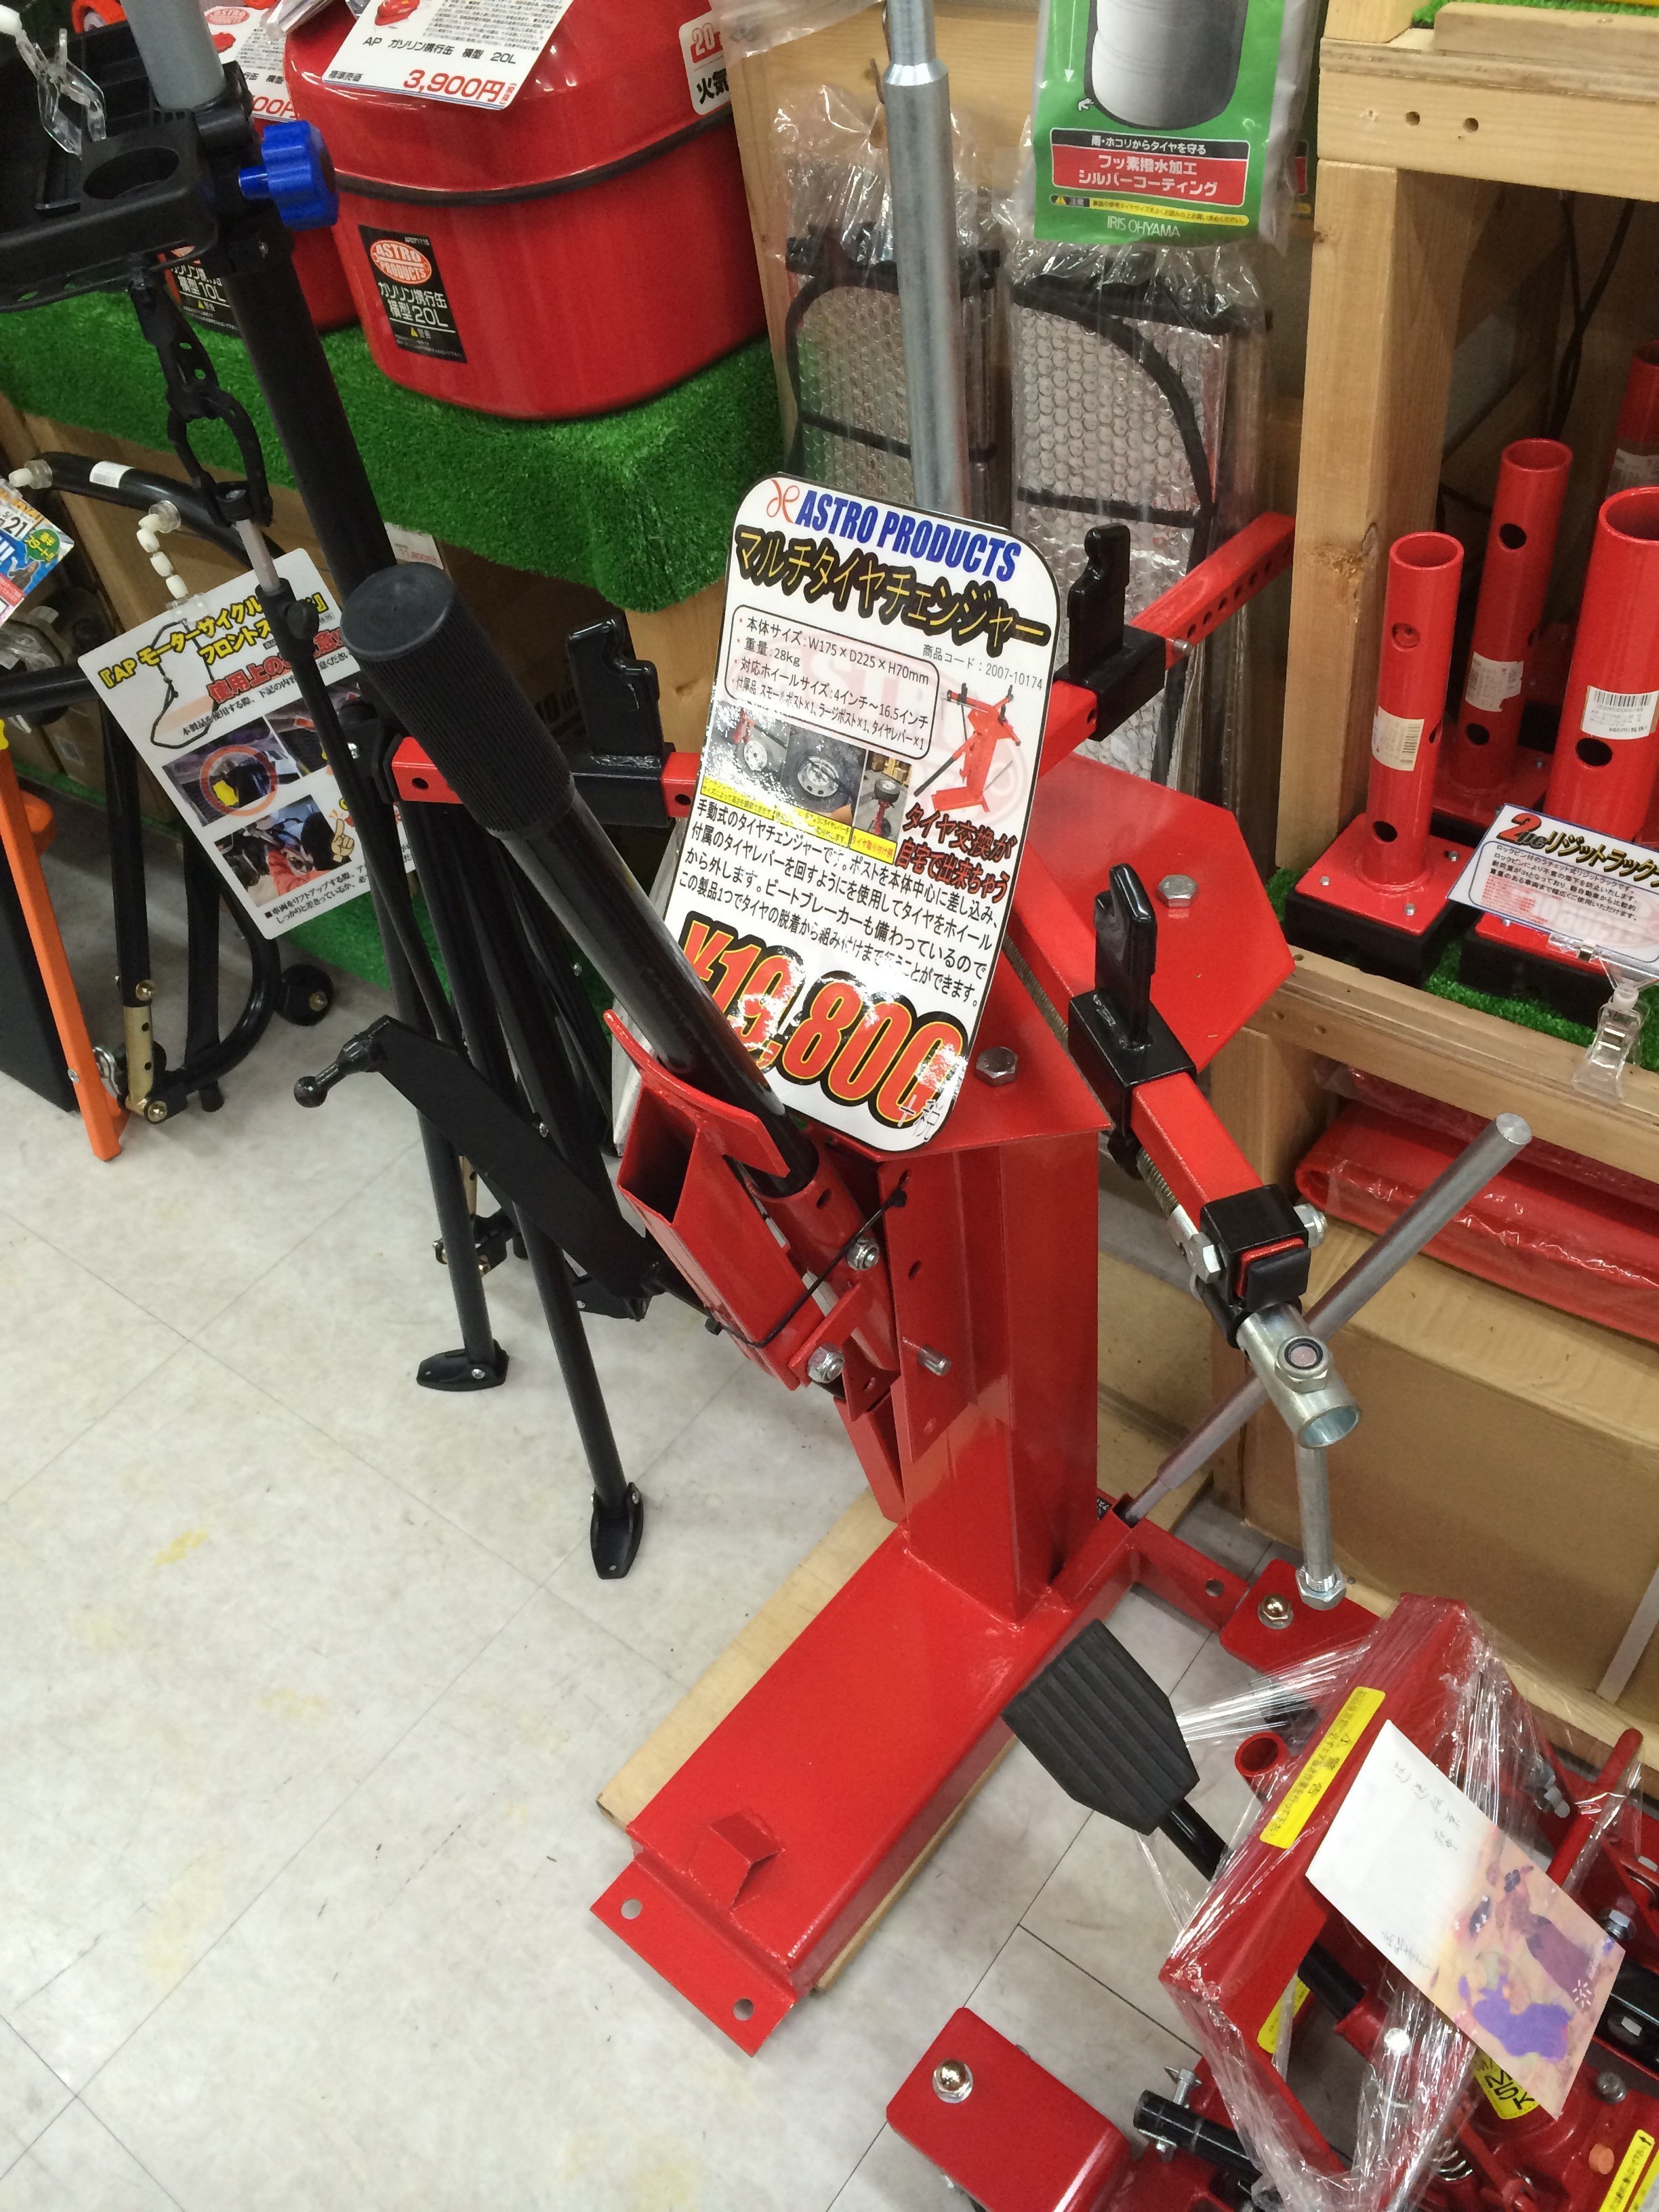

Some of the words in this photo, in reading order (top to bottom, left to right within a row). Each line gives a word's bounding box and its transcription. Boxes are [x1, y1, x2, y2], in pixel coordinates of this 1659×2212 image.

[363, 37, 382, 46] AP
[388, 39, 455, 56] ガソリン携行缶
[490, 52, 516, 64] 20L
[403, 69, 506, 102] 3,900円
[1091, 135, 1206, 155] 雨・ホコリからタイヤを守る
[1098, 155, 1197, 176] フッ素撥水加工
[1078, 169, 1218, 197] シルバーコーティング
[1107, 216, 1126, 231] IRIS
[1128, 220, 1181, 237] OHYAMA
[375, 243, 422, 262] ASTRO
[380, 261, 426, 281] PRODUCTS
[378, 281, 447, 309] ガソリン携行缶
[795, 490, 878, 544] ASTRO
[877, 510, 1021, 581] PRODUCTS
[736, 527, 1050, 655] マルチタイヤチェンジャー
[902, 802, 1017, 863] タイヤ交換が
[895, 836, 1010, 903] 自宅で出来ちゃう
